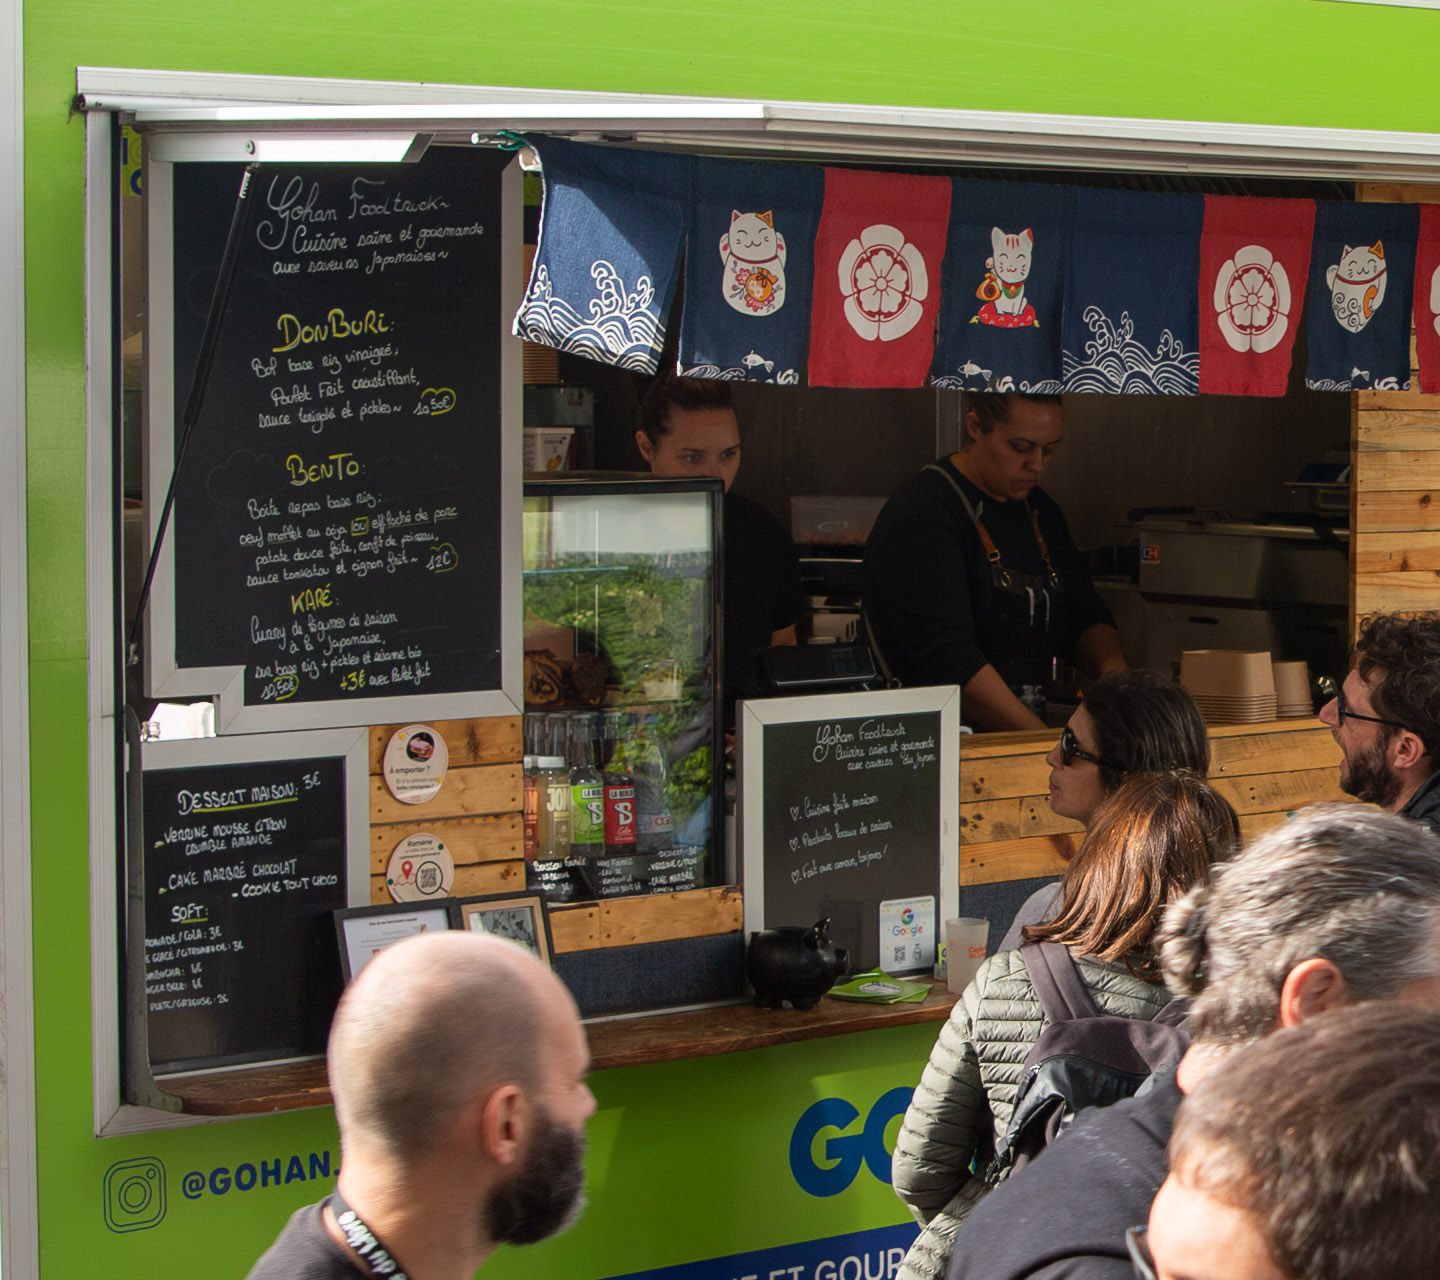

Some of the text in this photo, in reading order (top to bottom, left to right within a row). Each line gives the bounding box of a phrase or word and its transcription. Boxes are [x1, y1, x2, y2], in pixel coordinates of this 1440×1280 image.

[399, 224, 413, 241] et
[288, 358, 314, 372] base
[341, 400, 354, 418] et
[307, 528, 322, 538] au
[414, 507, 429, 521] de
[294, 547, 324, 561] douce
[247, 573, 279, 586] sauce
[336, 561, 348, 574] et
[251, 615, 286, 650] Curry
[292, 620, 303, 636] de
[349, 612, 360, 626] de
[177, 788, 247, 815] DESSERT
[213, 822, 249, 837] MOUSSE
[231, 834, 273, 848] AMANDE
[168, 870, 199, 890] CAKE
[252, 858, 298, 877] CHOCOLAT
[241, 882, 281, 897] COOKIE
[285, 877, 310, 891] TOUT
[892, 923, 923, 937] Google
